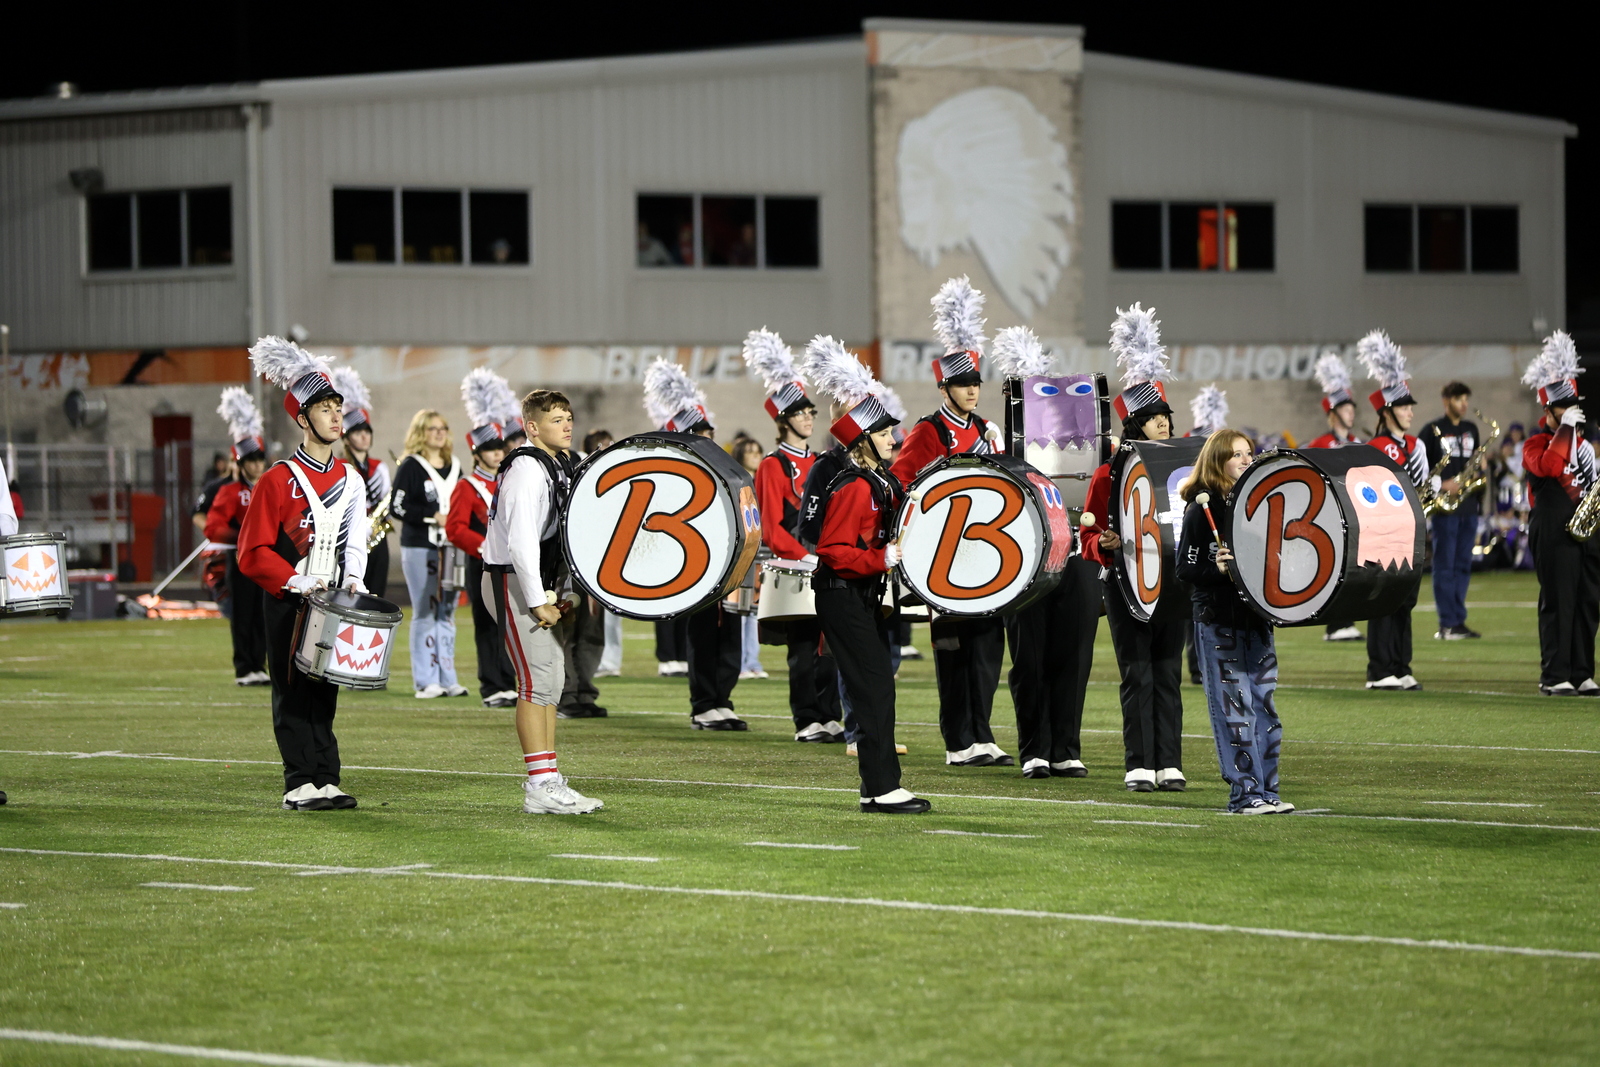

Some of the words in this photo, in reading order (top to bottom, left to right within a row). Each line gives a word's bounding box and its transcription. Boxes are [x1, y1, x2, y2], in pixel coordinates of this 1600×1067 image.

[1384, 443, 1400, 461] B
[596, 457, 717, 600] B
[921, 474, 1025, 600] B
[1123, 461, 1163, 604] B
[1245, 465, 1335, 608] B
[1214, 625, 1260, 798] SENIOR
